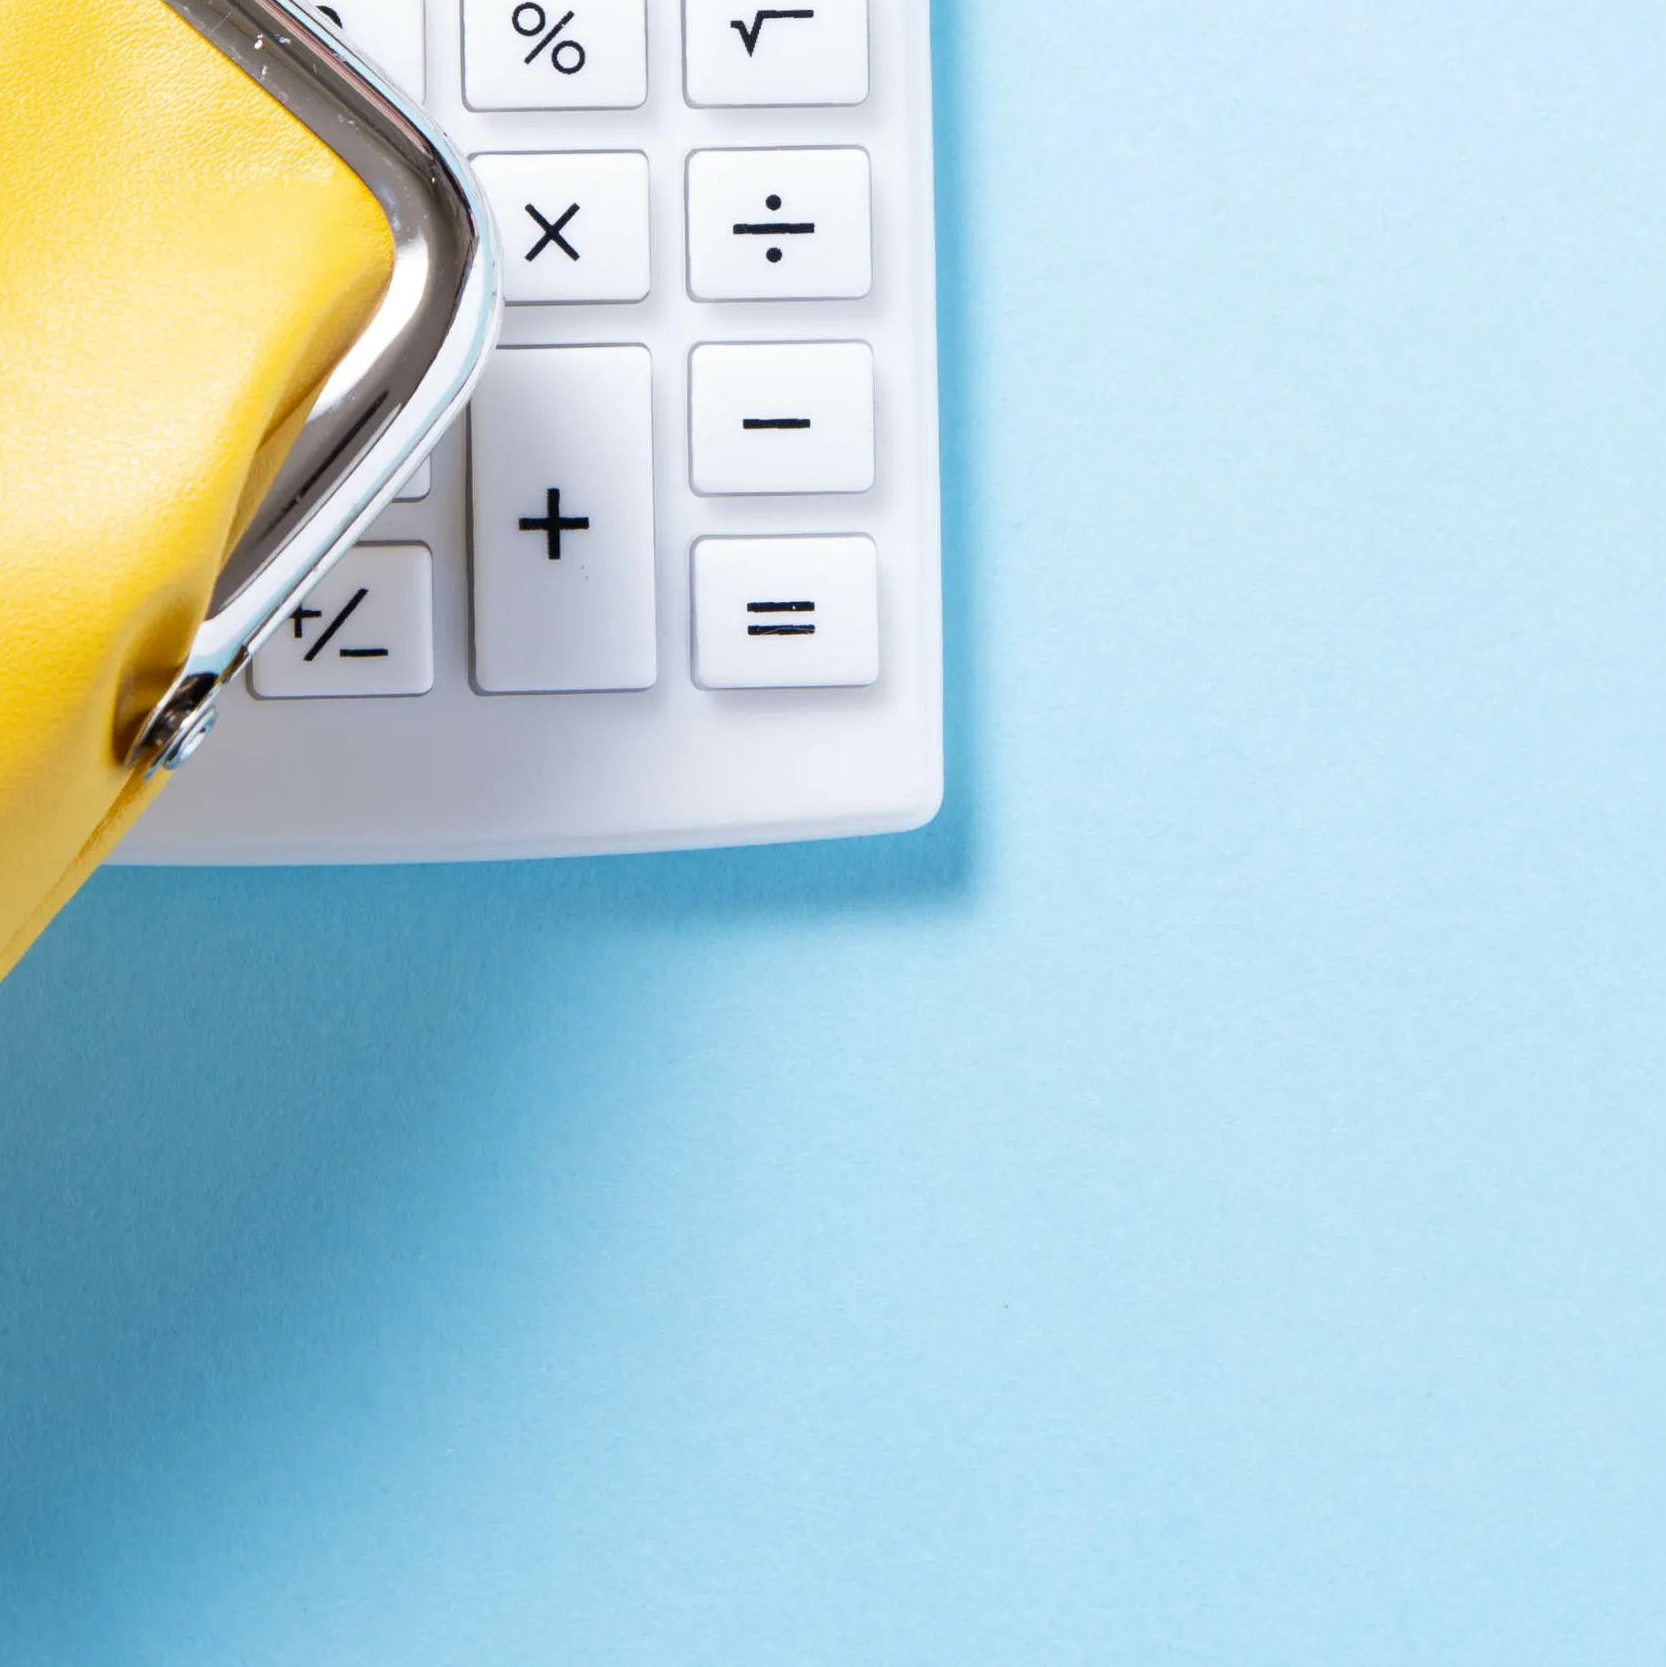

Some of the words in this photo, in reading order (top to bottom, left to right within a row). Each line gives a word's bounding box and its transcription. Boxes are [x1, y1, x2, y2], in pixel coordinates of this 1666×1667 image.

[511, 1, 586, 75] %
[732, 194, 815, 263] ÷
[517, 487, 590, 561] +
[746, 601, 816, 636] =
